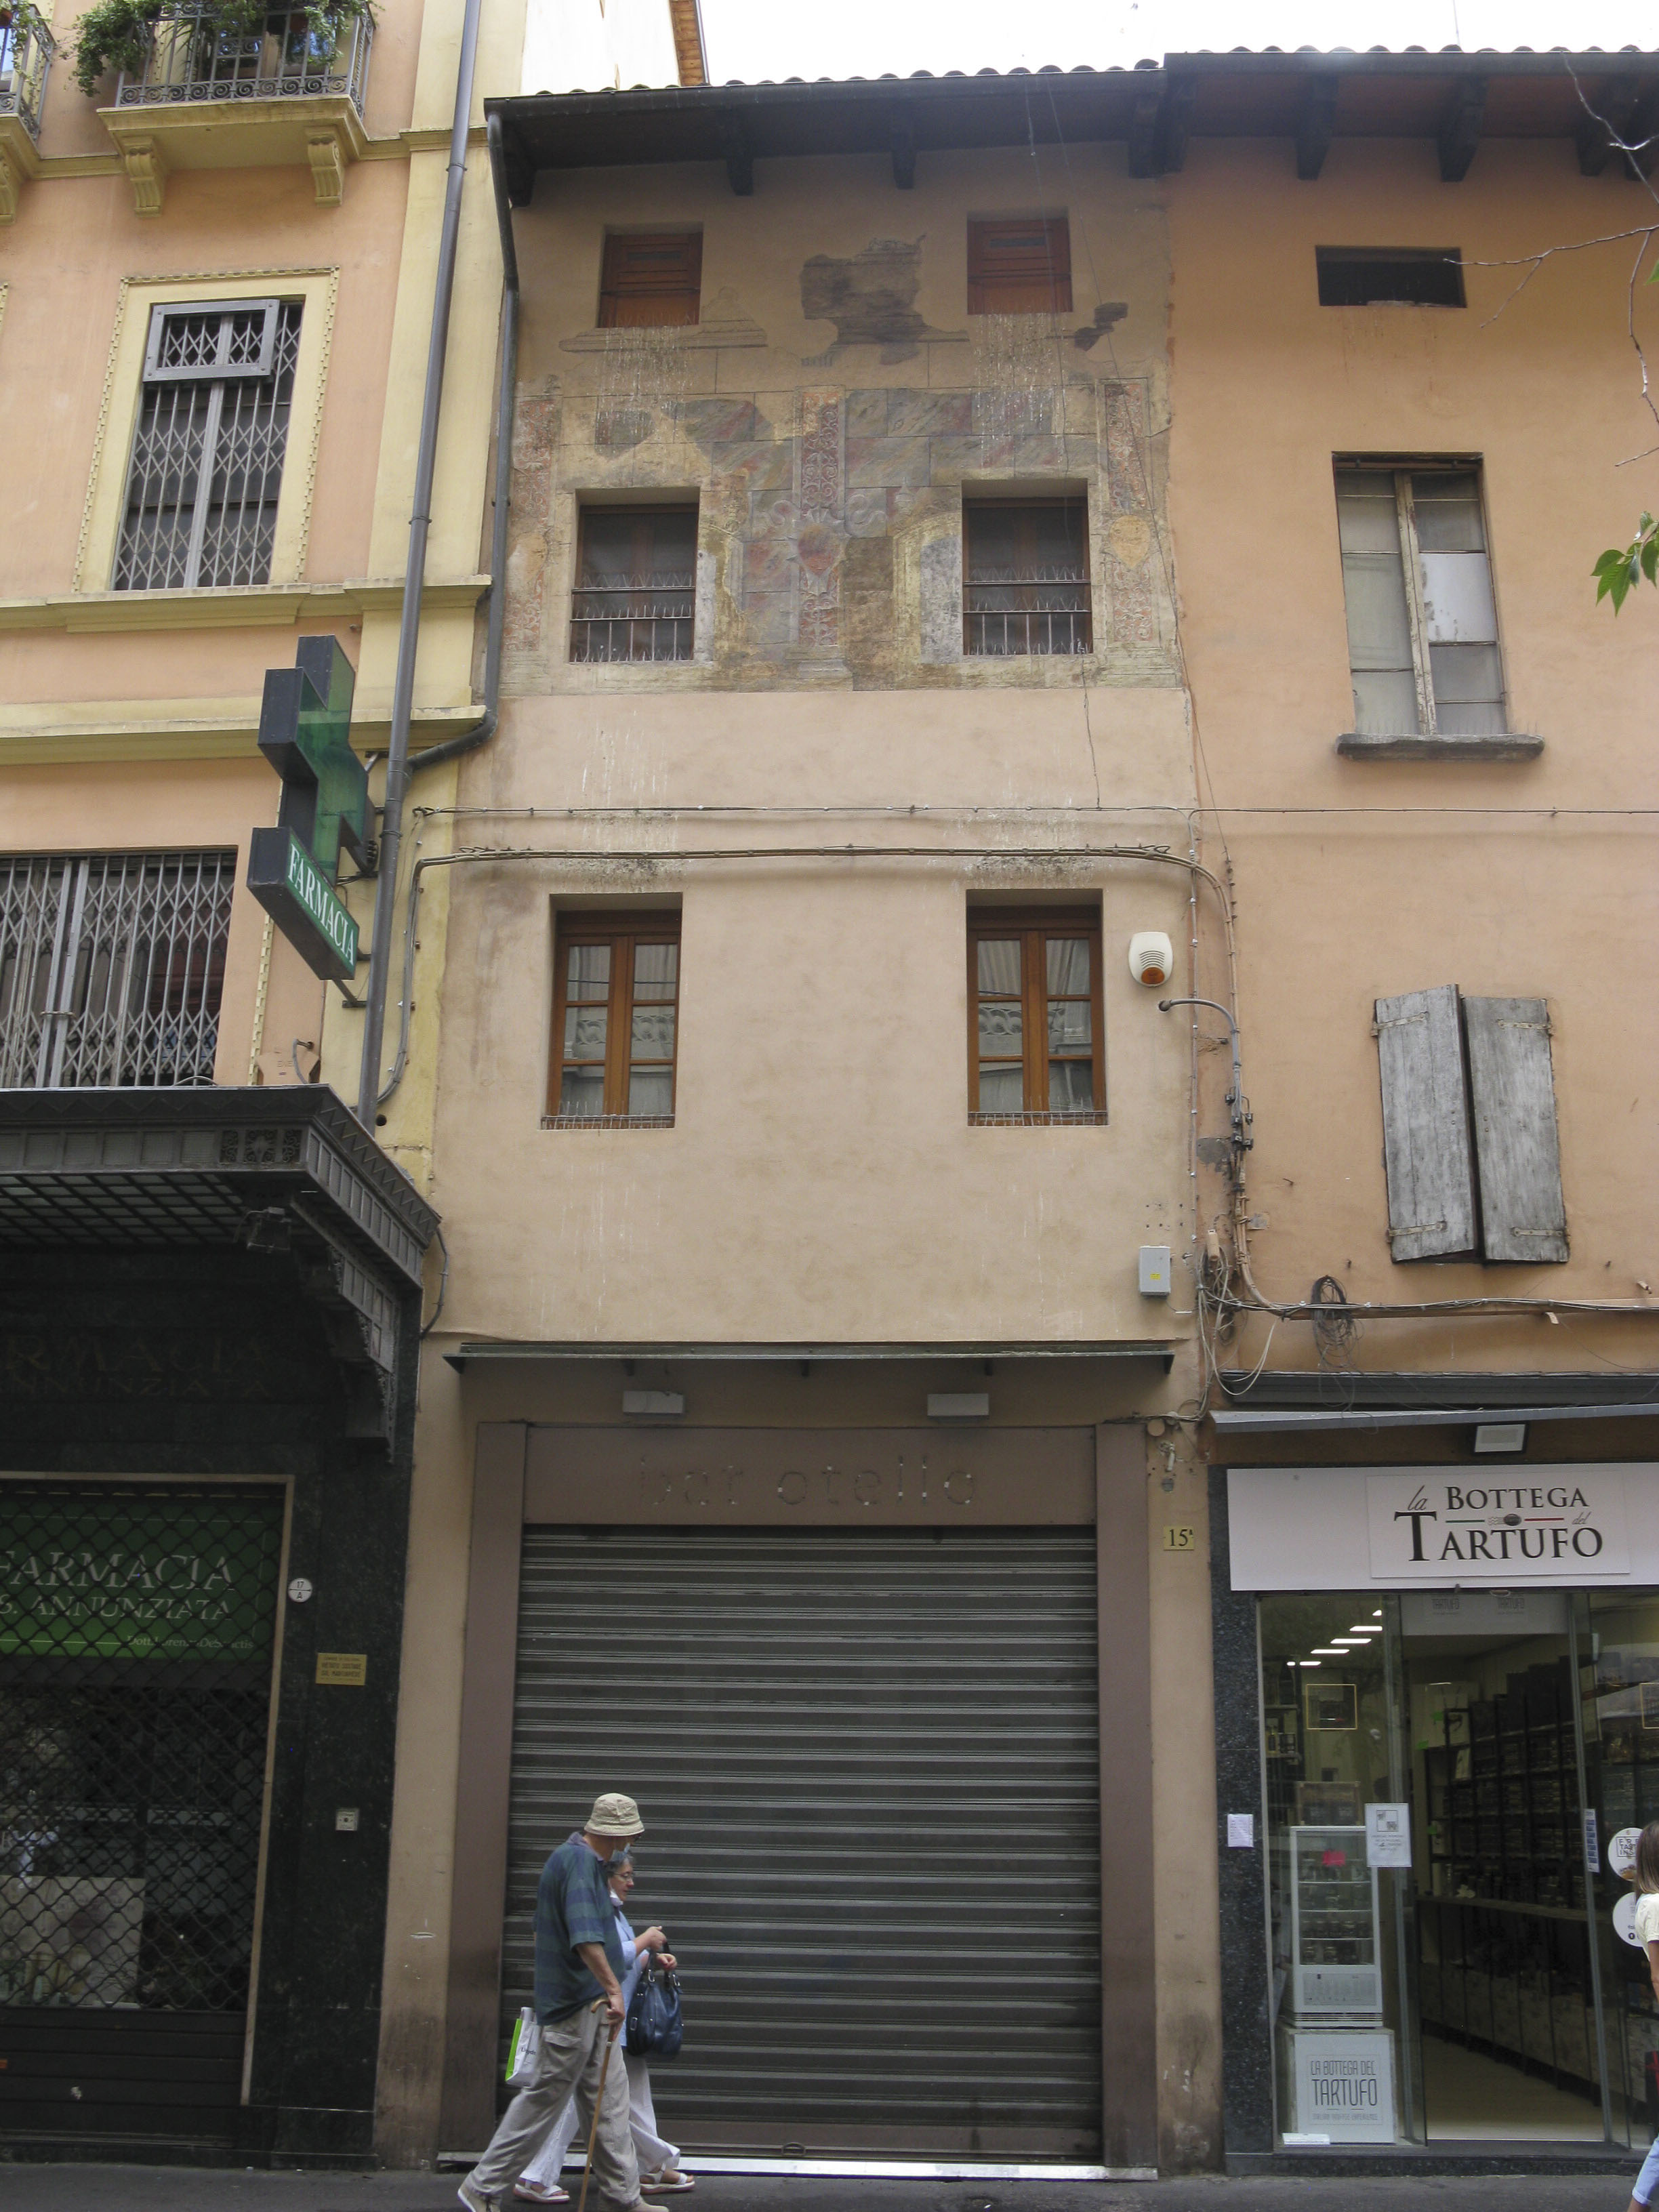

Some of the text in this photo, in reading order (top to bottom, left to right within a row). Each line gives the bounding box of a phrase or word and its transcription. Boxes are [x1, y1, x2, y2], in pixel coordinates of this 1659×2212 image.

[288, 843, 354, 966] FARMACIA
[776, 1455, 976, 1506] otello
[1407, 1485, 1590, 1511] la BOTTEGA
[1572, 1511, 1592, 1525] del
[1393, 1511, 1603, 1561] TARTUFO
[30, 1595, 233, 1621] ANNUNZIATA
[1311, 2060, 1377, 2075] LA BOTTEGA DEL
[1311, 2078, 1378, 2106] TARTUFO
